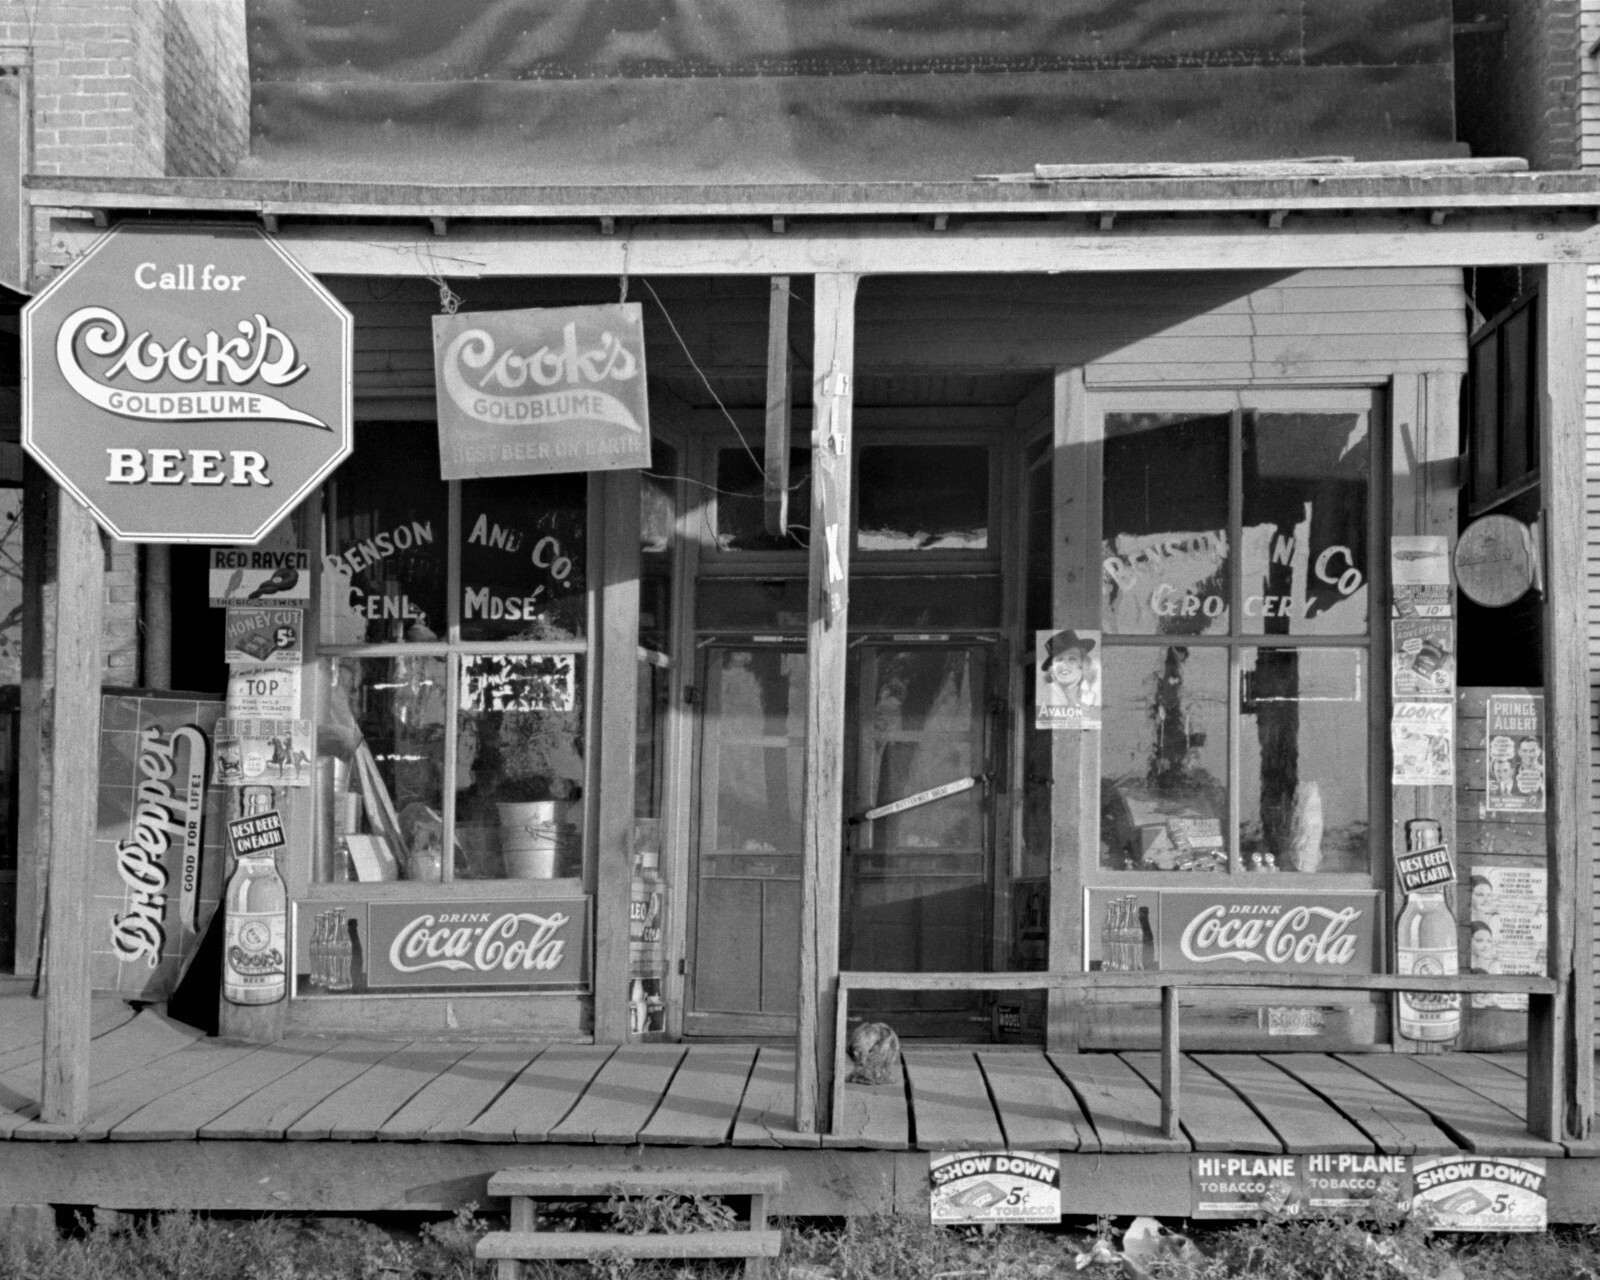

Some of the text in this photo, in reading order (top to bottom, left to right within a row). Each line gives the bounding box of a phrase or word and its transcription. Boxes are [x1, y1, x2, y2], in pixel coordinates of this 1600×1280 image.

[134, 262, 246, 291] Call for
[56, 306, 330, 422] Cook's
[444, 321, 640, 428] Cook's
[108, 392, 261, 414] GOLDBLUME
[473, 395, 604, 420] GOLDBLUME
[501, 442, 550, 460] BEER
[105, 448, 272, 486] BEER
[215, 551, 307, 569] RED RAVEN
[325, 520, 433, 578] BENSON
[227, 611, 299, 638] HONEY CUT
[246, 680, 279, 695] TOP
[1038, 702, 1083, 718] AVALON
[1395, 705, 1449, 719] LOOK!
[1494, 703, 1537, 715] PRINCE
[260, 719, 311, 736] BEN
[1494, 716, 1538, 730] ALBERT
[184, 774, 201, 892] GOOD FOR LIFE!
[232, 815, 281, 838] BEST BEER
[237, 829, 281, 852] ON EARTH
[1400, 850, 1448, 873] BEST BEER
[1406, 864, 1450, 887] ON EARTH
[438, 912, 491, 924] DRINK
[1229, 905, 1282, 914] DRINK
[389, 912, 569, 973] Coca-Cola
[1180, 904, 1362, 965] Coca-Cola
[933, 1157, 1055, 1184] SHOW DOWN
[1198, 1158, 1295, 1176] HI-PLANE
[1309, 1154, 1407, 1172] HI-PLANE
[1200, 1182, 1266, 1193] TOBACCO
[1310, 1178, 1376, 1189] TOBACCO
[1416, 1162, 1541, 1191] SHOW DOWN
[995, 1205, 1055, 1217] TOBACCO
